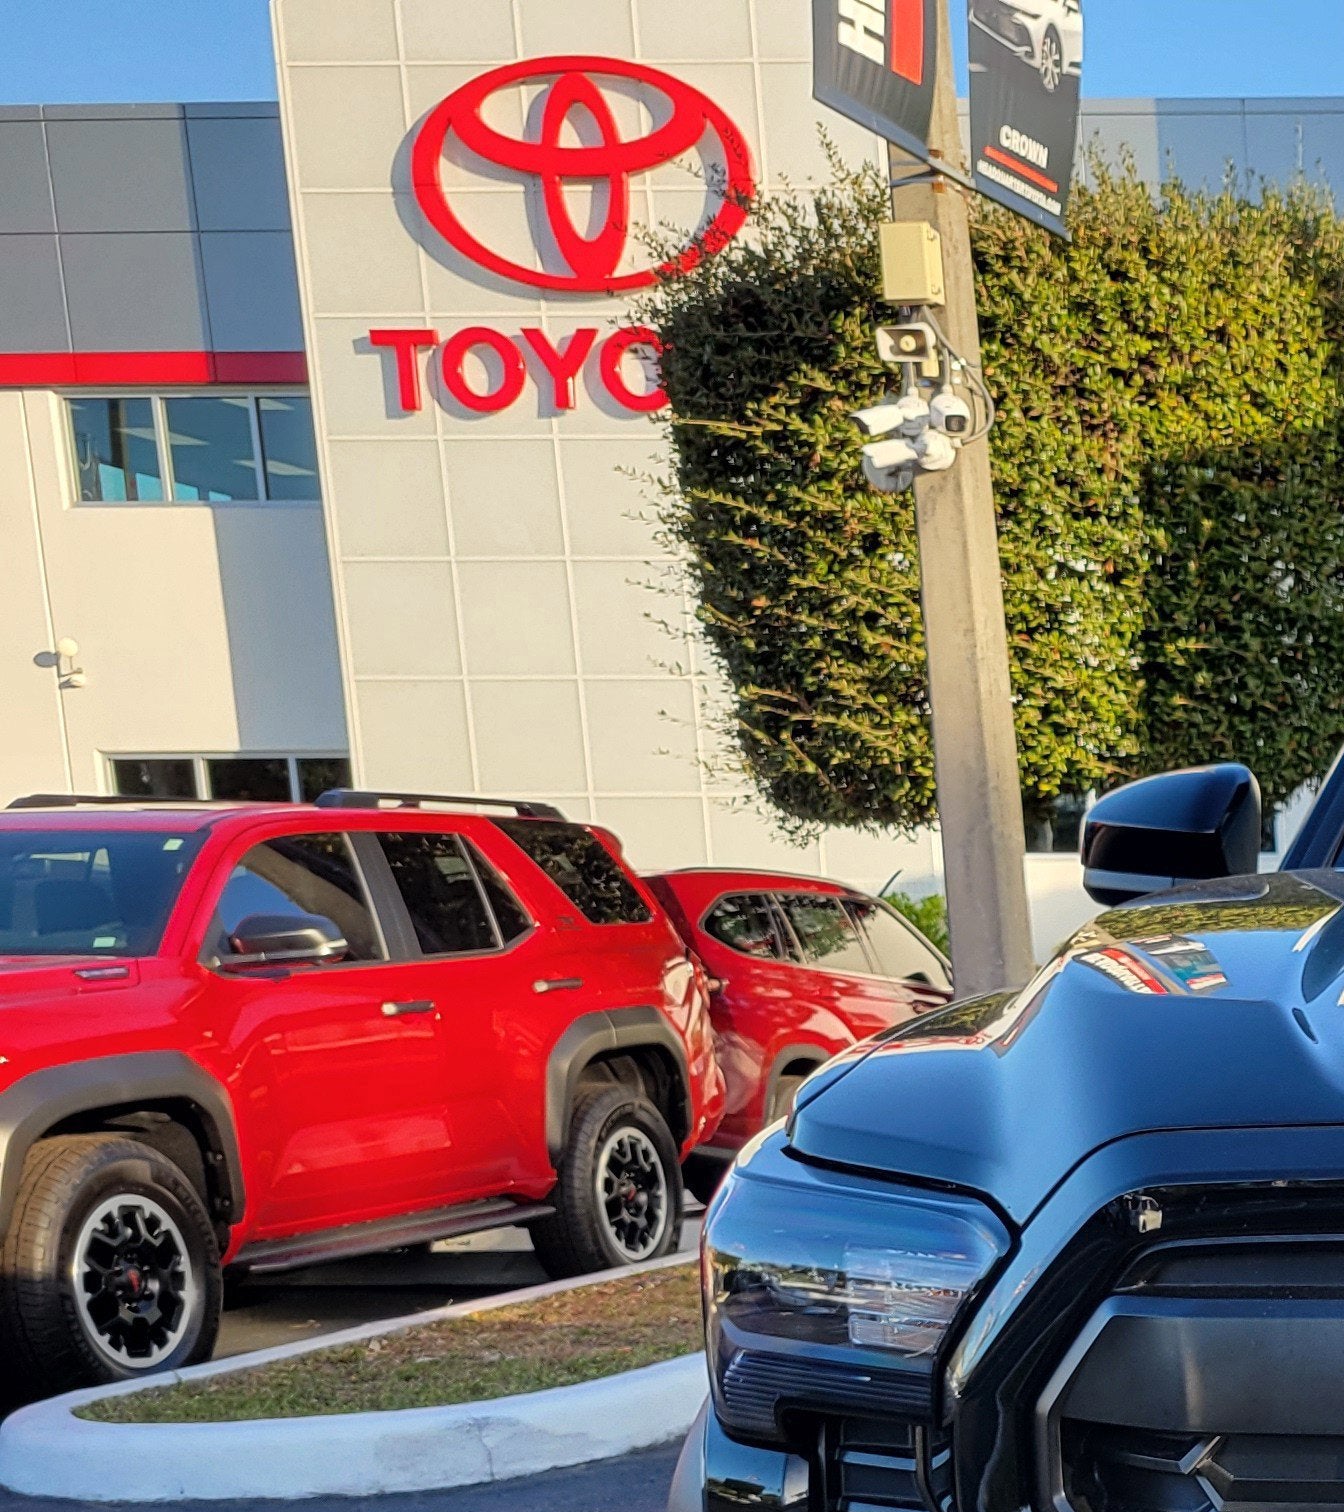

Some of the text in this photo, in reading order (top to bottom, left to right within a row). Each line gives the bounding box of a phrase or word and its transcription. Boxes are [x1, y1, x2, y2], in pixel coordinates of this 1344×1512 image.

[838, 0, 884, 66] H
[1000, 125, 1048, 169] CROWN
[369, 326, 669, 412] TOYO
